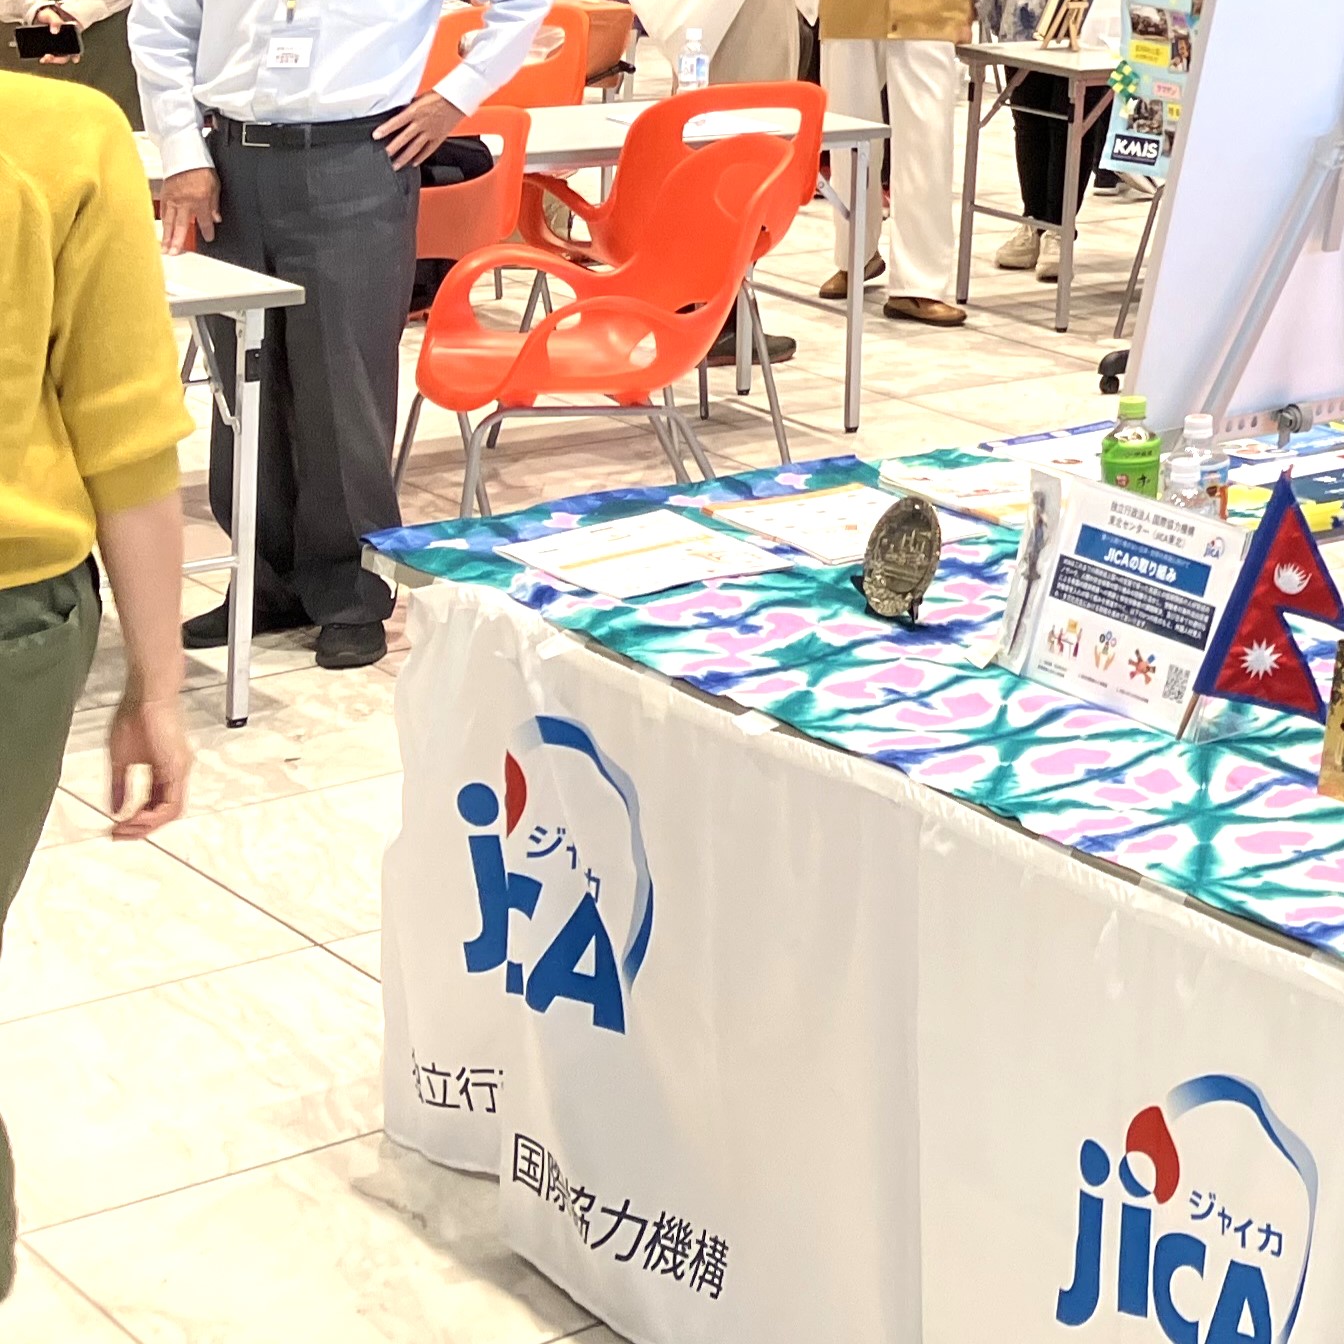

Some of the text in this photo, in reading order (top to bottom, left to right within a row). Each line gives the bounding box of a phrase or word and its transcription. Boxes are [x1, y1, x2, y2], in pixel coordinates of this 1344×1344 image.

[1113, 137, 1159, 159] KMIS
[1188, 1189, 1284, 1258] ジャイカ
